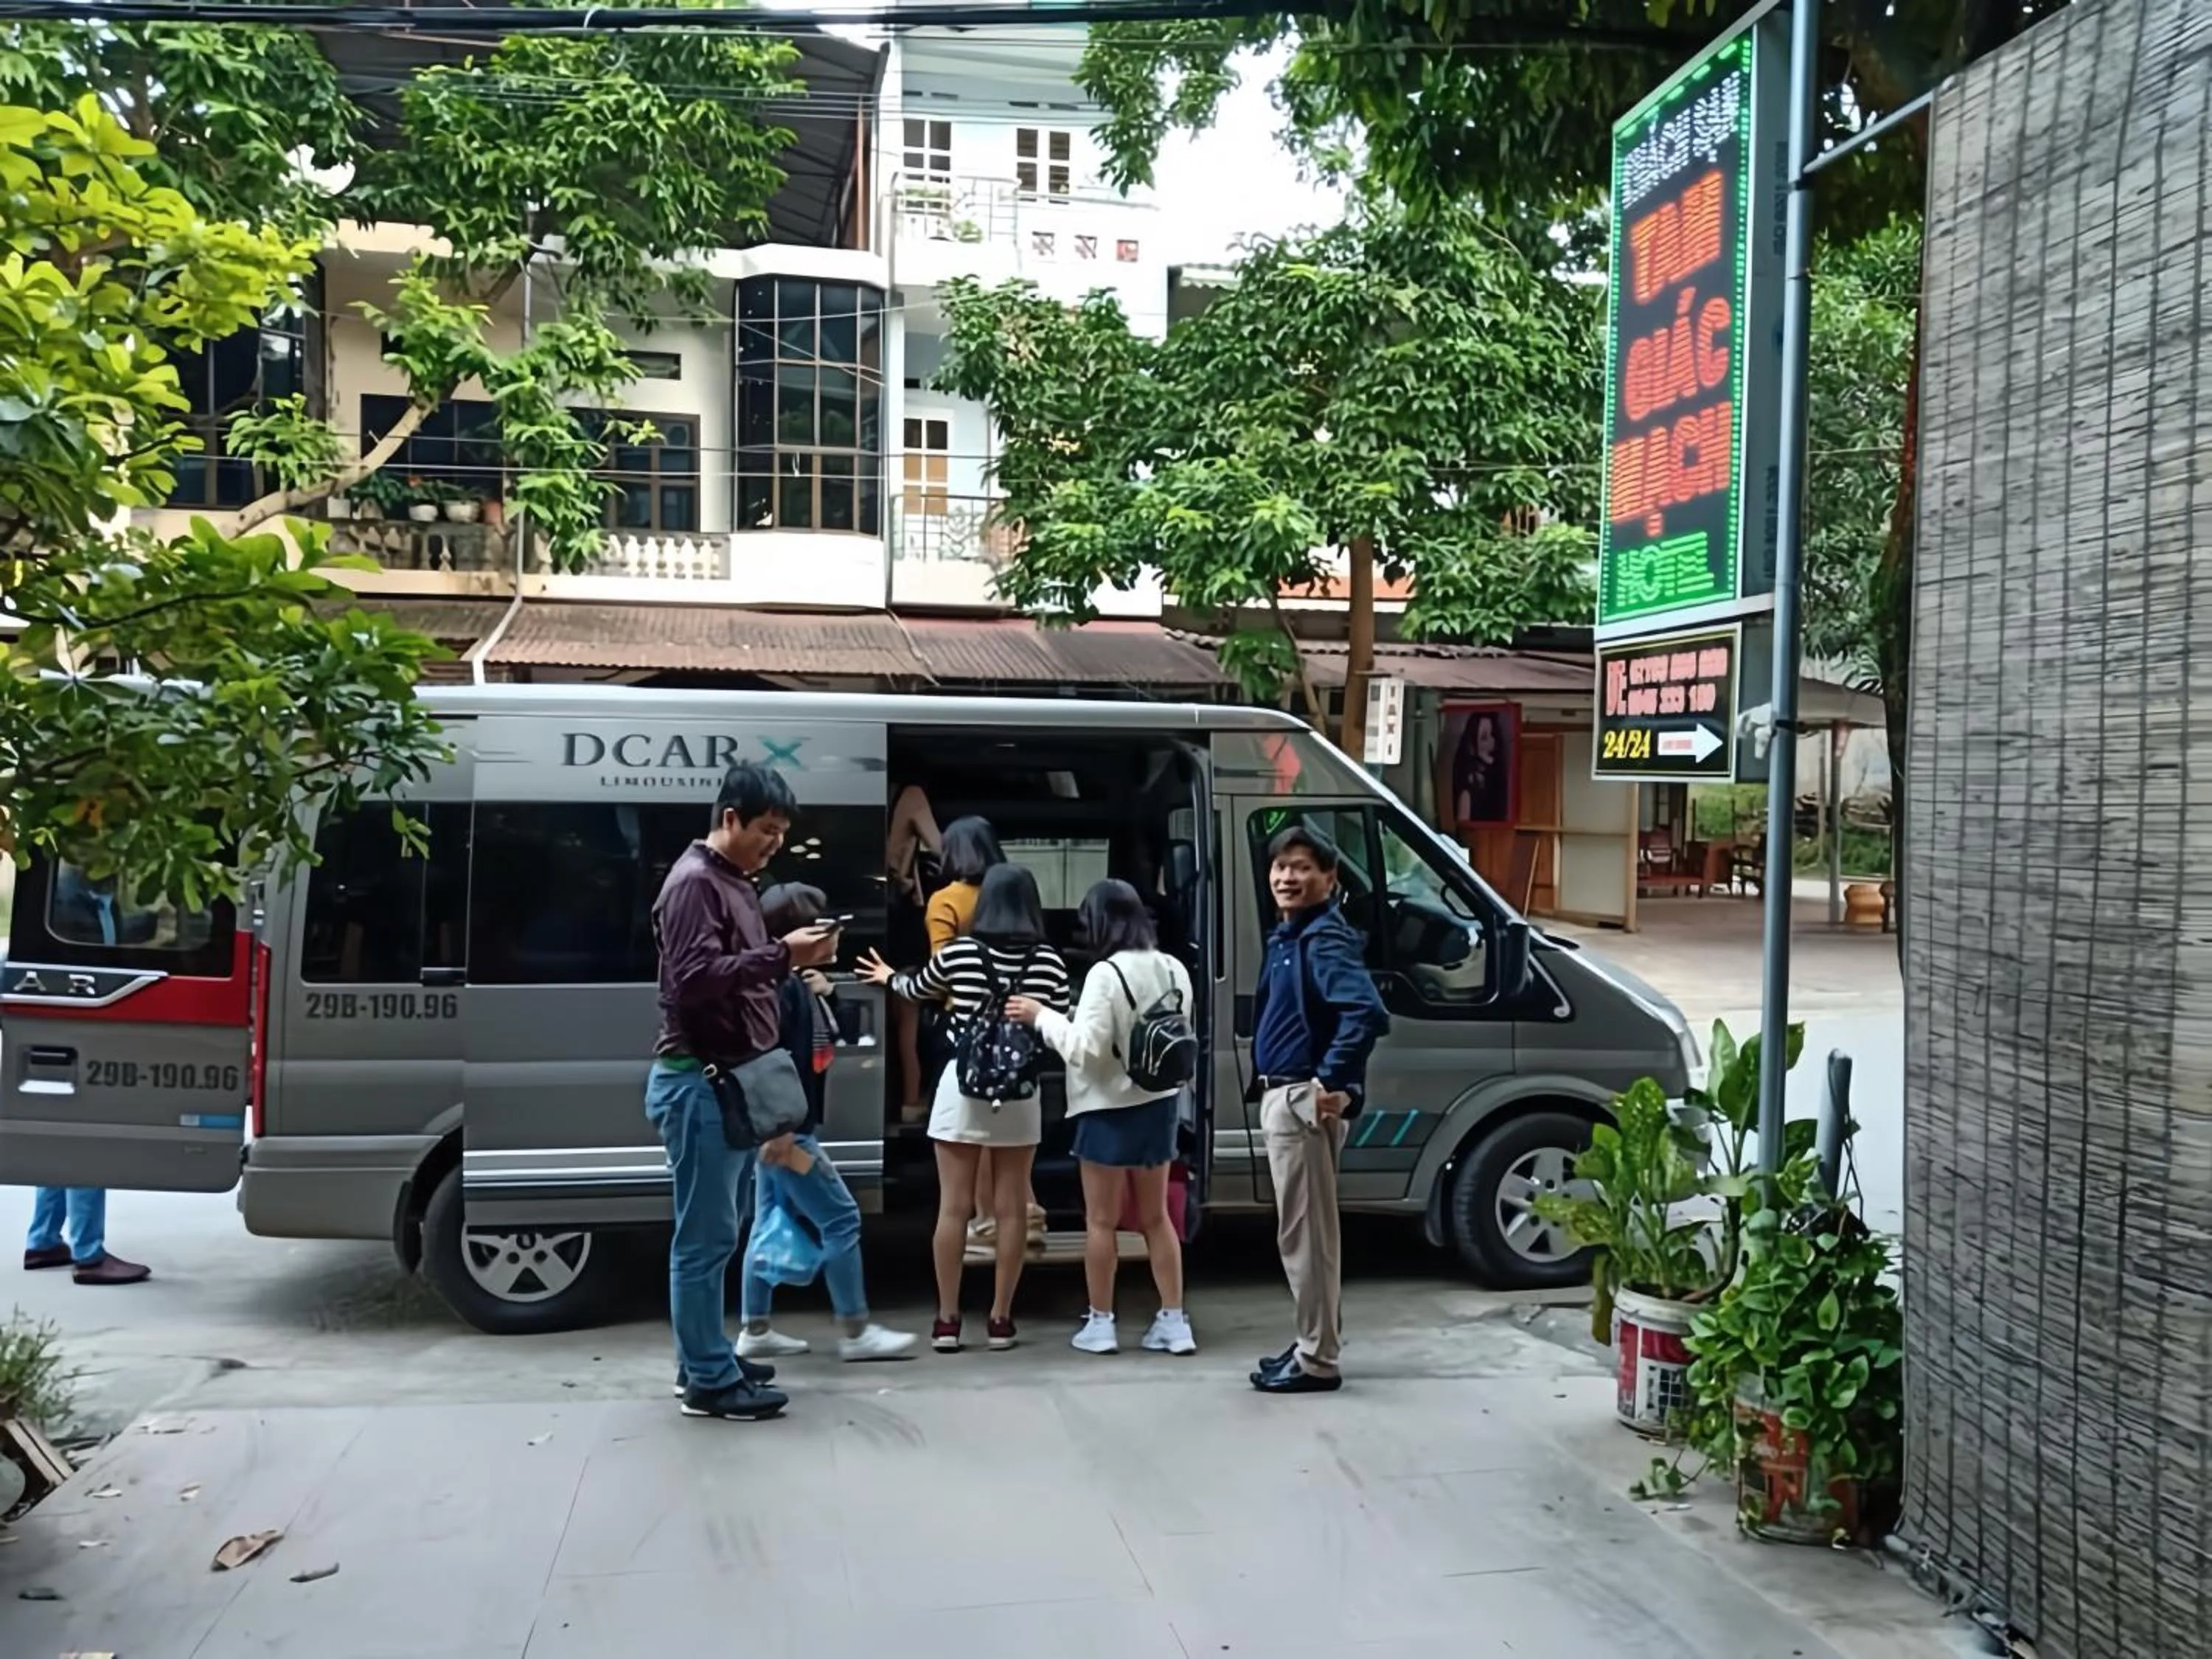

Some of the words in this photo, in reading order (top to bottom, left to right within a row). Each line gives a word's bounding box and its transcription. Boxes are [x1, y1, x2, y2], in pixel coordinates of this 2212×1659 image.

[1625, 286, 1731, 422] GIÁC
[1616, 531, 1714, 608] HOTEL
[561, 733, 738, 768] DCAR
[1602, 729, 1652, 759] 24/24
[306, 992, 459, 1020] 29B-190.96
[86, 1060, 240, 1091] 29B-190.96
